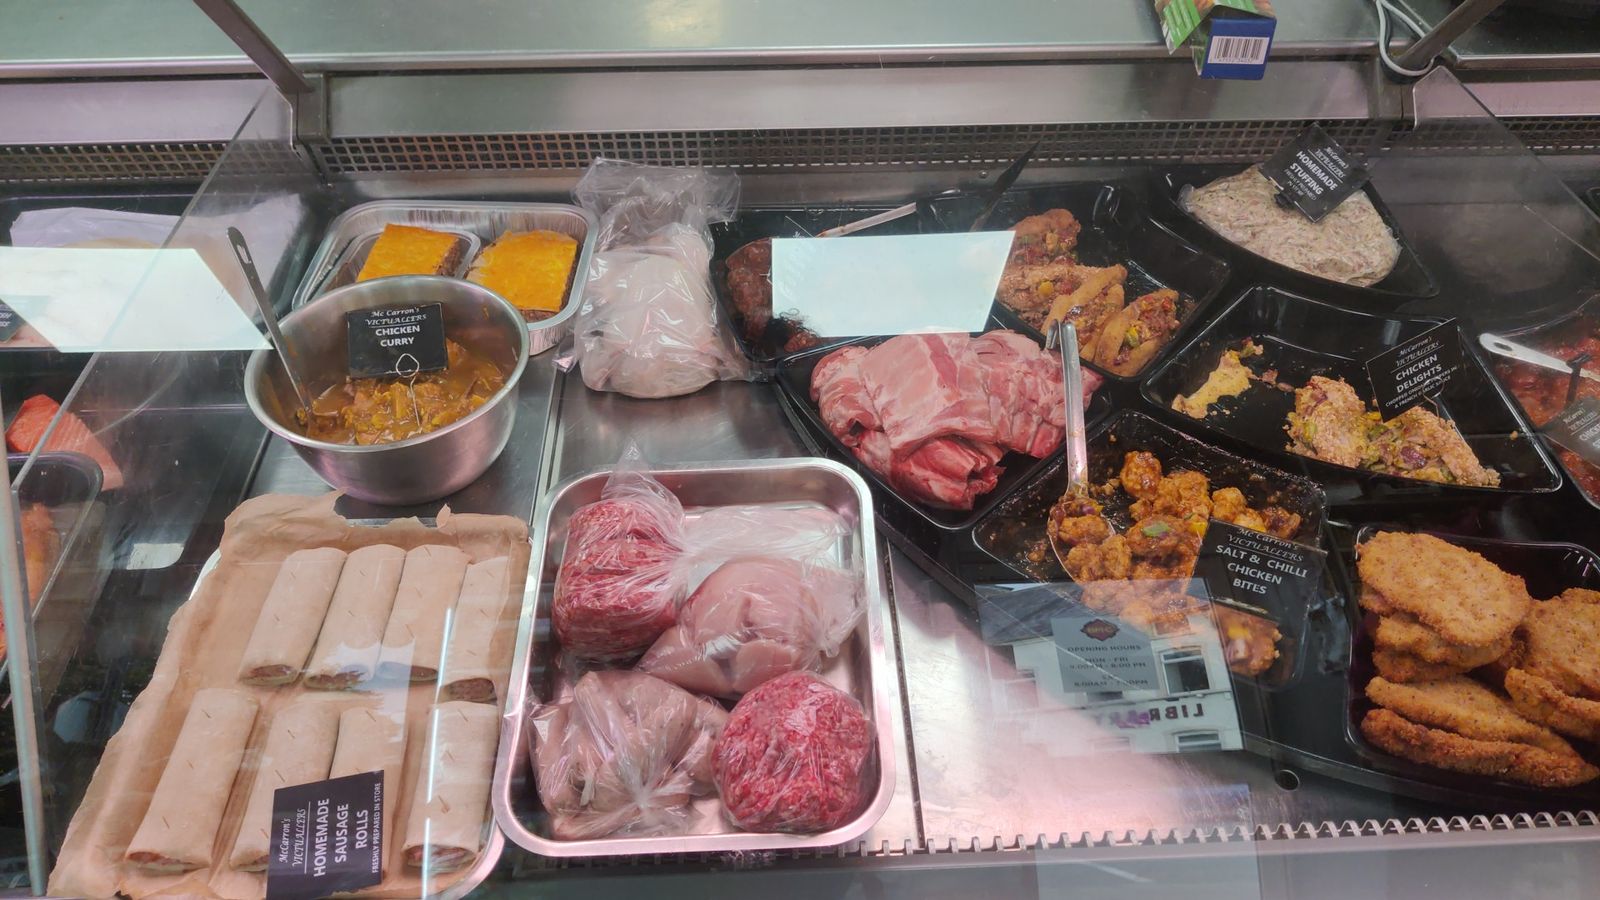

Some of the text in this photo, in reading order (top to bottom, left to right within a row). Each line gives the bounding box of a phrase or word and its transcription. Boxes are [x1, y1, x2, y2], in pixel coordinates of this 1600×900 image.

[1289, 162, 1324, 195] STUFFING
[1296, 150, 1338, 191] HOMEMADE
[365, 314, 427, 326] VICTUALLERS
[386, 306, 420, 317] Carron's
[375, 325, 421, 337] CHICKEN
[380, 337, 415, 348] CURRY
[1396, 354, 1438, 381] CHICKEN
[1396, 364, 1442, 393] DELIGHTS
[1228, 534, 1304, 561] VICTUALLERS
[1256, 533, 1298, 551] Carron's
[1216, 545, 1308, 578] SALT & CHILLI
[1227, 563, 1282, 584] CHICKEN
[1233, 578, 1267, 594] BITES
[373, 783, 381, 802] STORE
[373, 803, 380, 811] IN
[279, 817, 290, 863] McCarron's
[292, 808, 305, 867] VICTUALLERS
[313, 798, 329, 877] HOMEMADE
[334, 803, 348, 863] SAUSAGE
[355, 809, 368, 849] ROLLS
